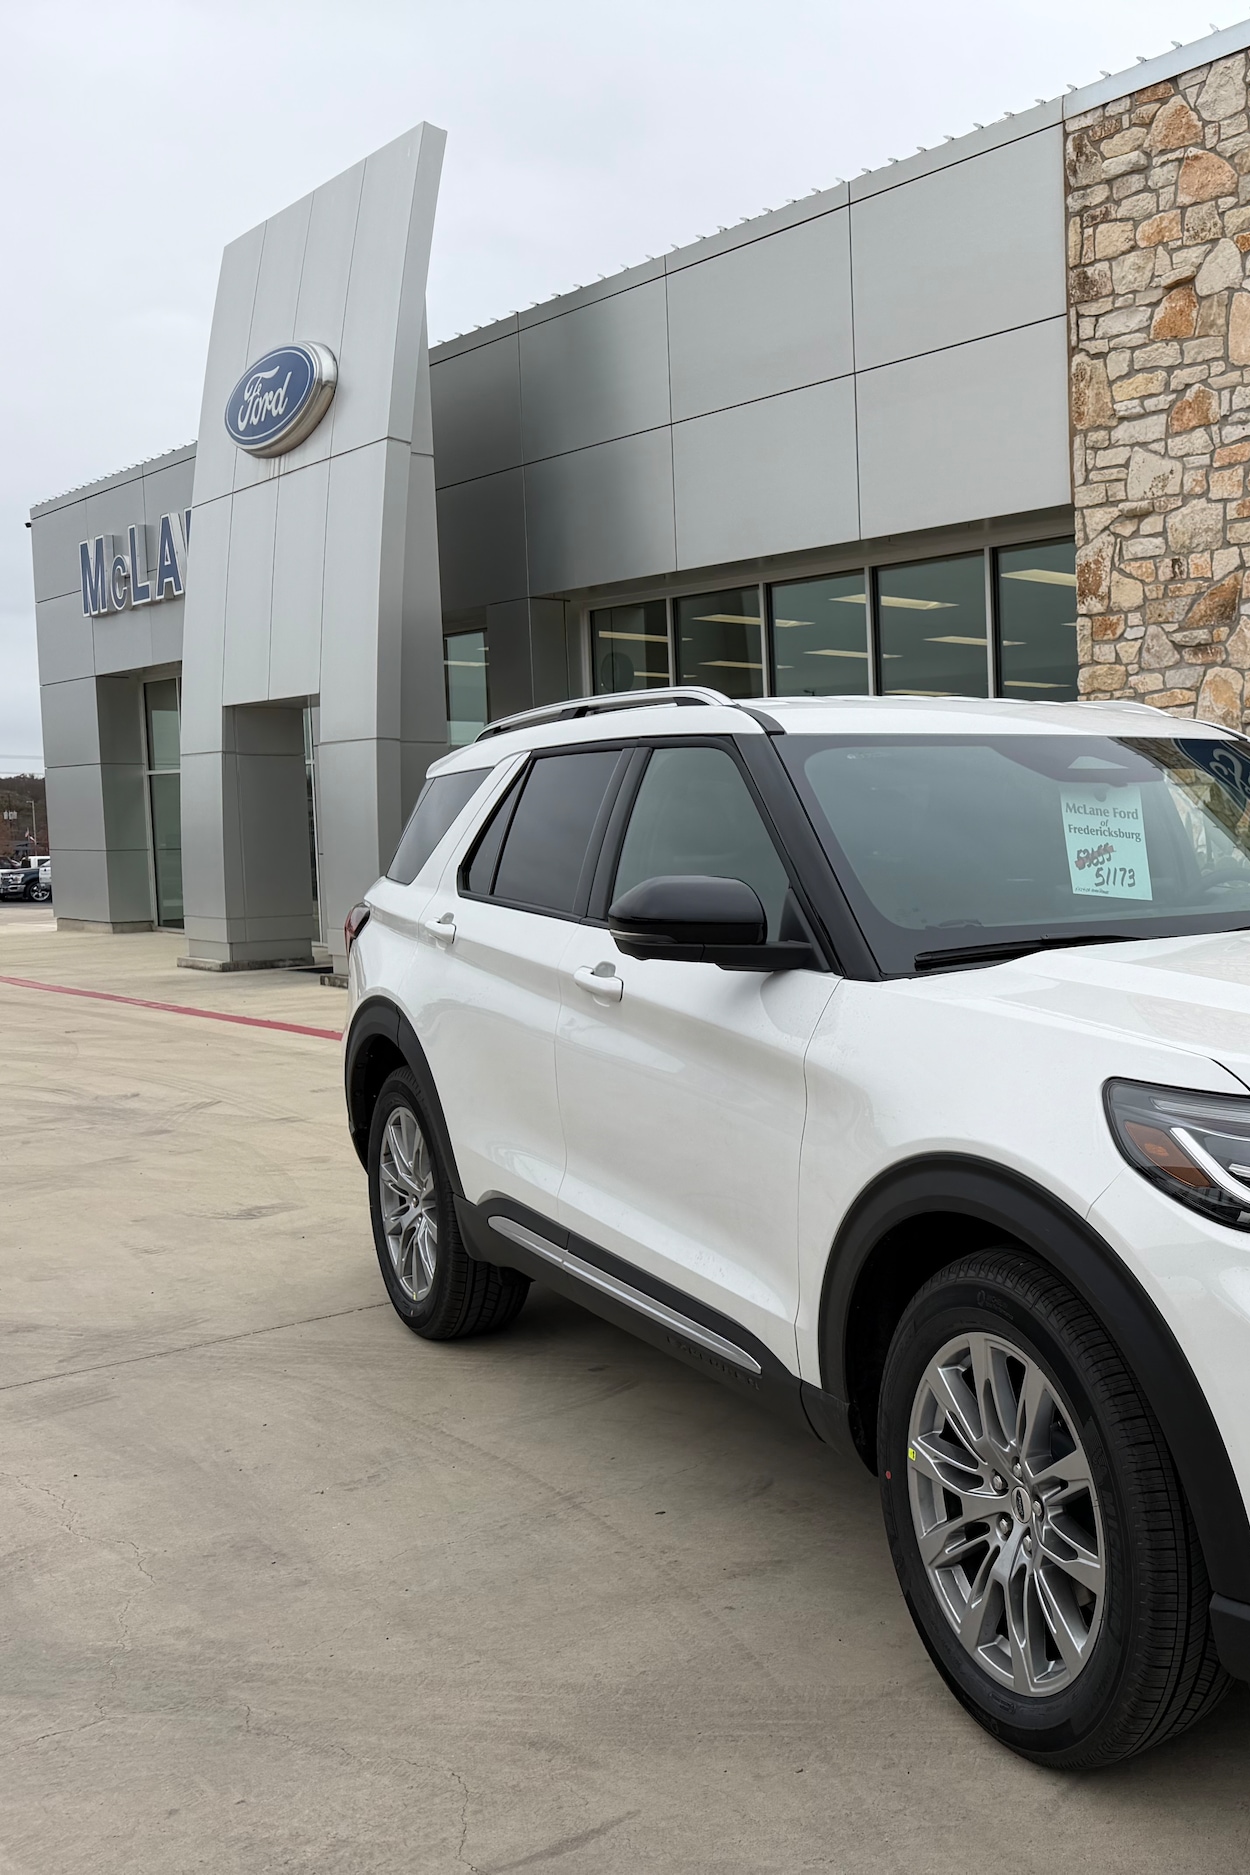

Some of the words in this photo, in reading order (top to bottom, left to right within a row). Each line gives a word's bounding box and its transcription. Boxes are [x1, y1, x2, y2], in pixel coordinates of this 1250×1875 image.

[238, 366, 292, 431] Ford
[1065, 802, 1110, 817] McLane
[1112, 807, 1139, 820] Ford
[1100, 819, 1109, 827] of
[1067, 824, 1142, 843] Fredericksburg
[1094, 867, 1136, 888] 51173
